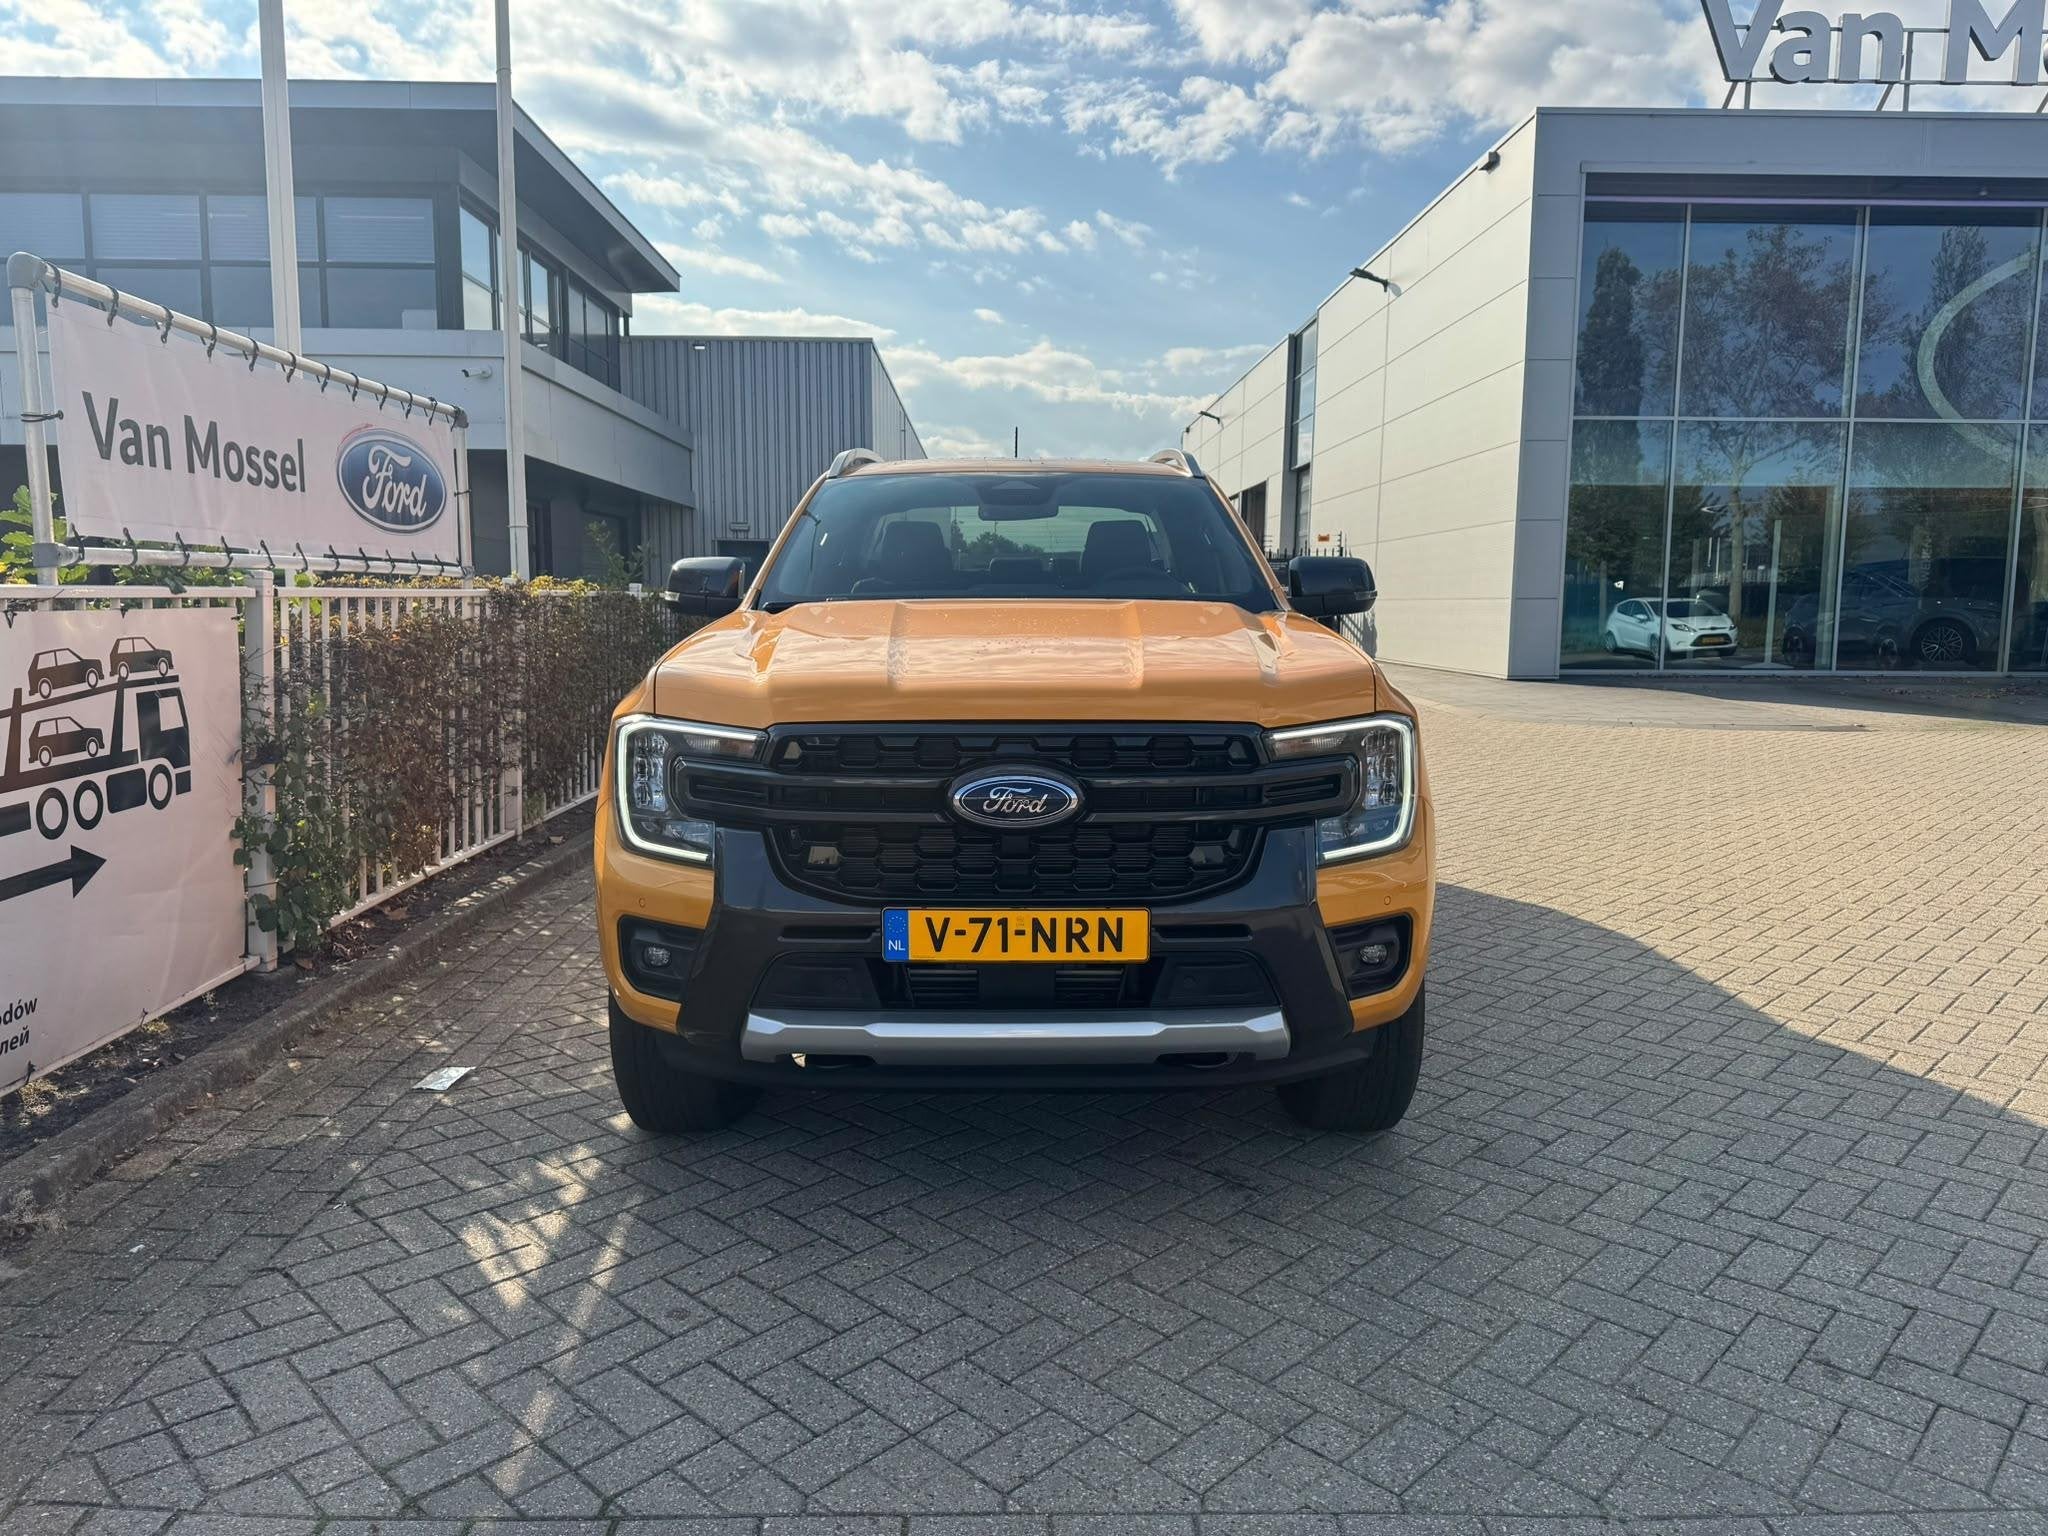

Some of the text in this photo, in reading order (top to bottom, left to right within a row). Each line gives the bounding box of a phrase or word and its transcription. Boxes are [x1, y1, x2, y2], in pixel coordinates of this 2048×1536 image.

[1701, 0, 2048, 86] Van M
[82, 390, 305, 492] Van Mossel
[362, 445, 427, 517] Ford
[983, 786, 1047, 813] Ford
[888, 939, 906, 951] NL
[925, 916, 1124, 953] V-71-NRN
[0, 998, 38, 1025] dów
